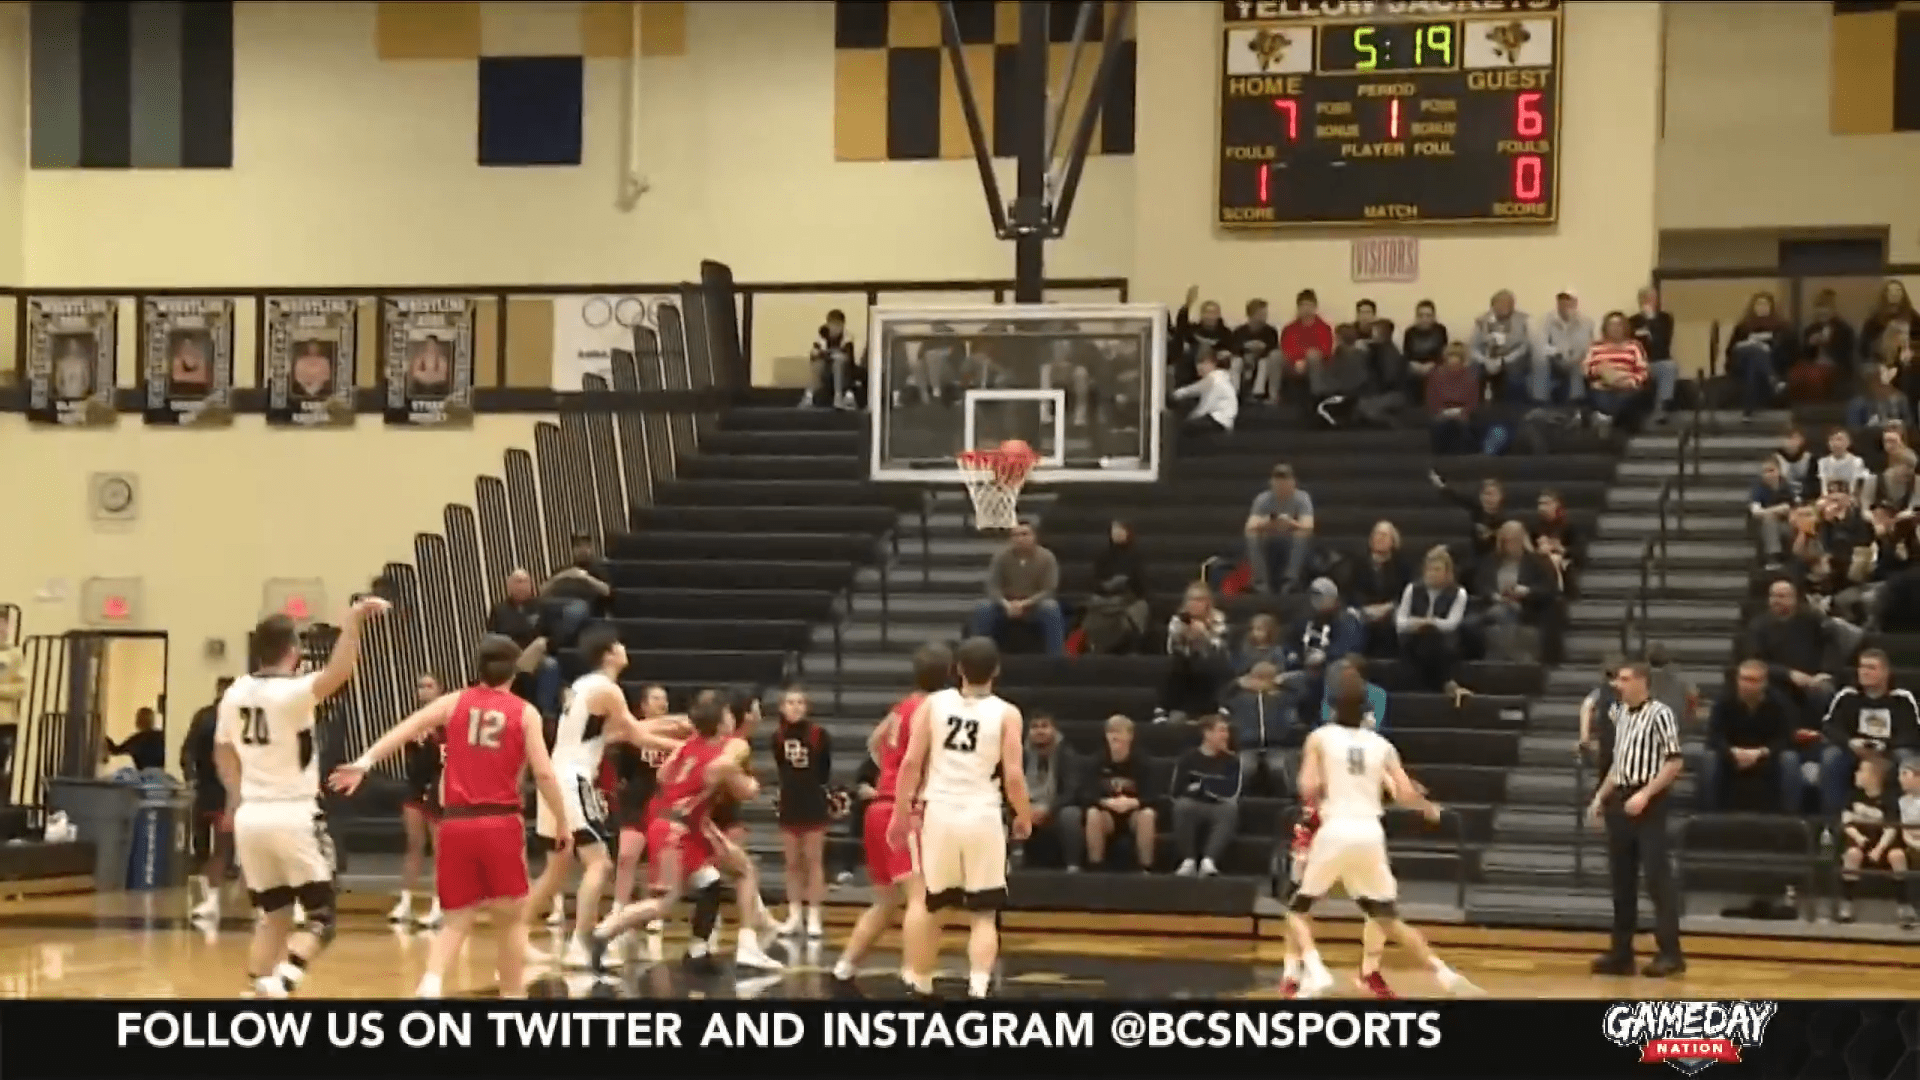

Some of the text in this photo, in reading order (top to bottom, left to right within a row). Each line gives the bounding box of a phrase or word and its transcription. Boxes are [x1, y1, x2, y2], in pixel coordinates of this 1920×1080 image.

[1353, 25, 1452, 69] 5:19
[1230, 77, 1303, 95] HOME
[1357, 83, 1415, 97] PERIOD
[1467, 70, 1549, 90] GUEST
[1274, 99, 1297, 139] 7
[1390, 99, 1399, 138] 1
[1517, 93, 1543, 136] 6
[1341, 141, 1455, 157] PLAYER FOUL
[1259, 164, 1268, 202] 1
[1515, 156, 1541, 199] 0
[1364, 204, 1418, 219] MATCH
[239, 706, 270, 745] 20
[468, 706, 507, 748] 12
[943, 714, 980, 754] 23
